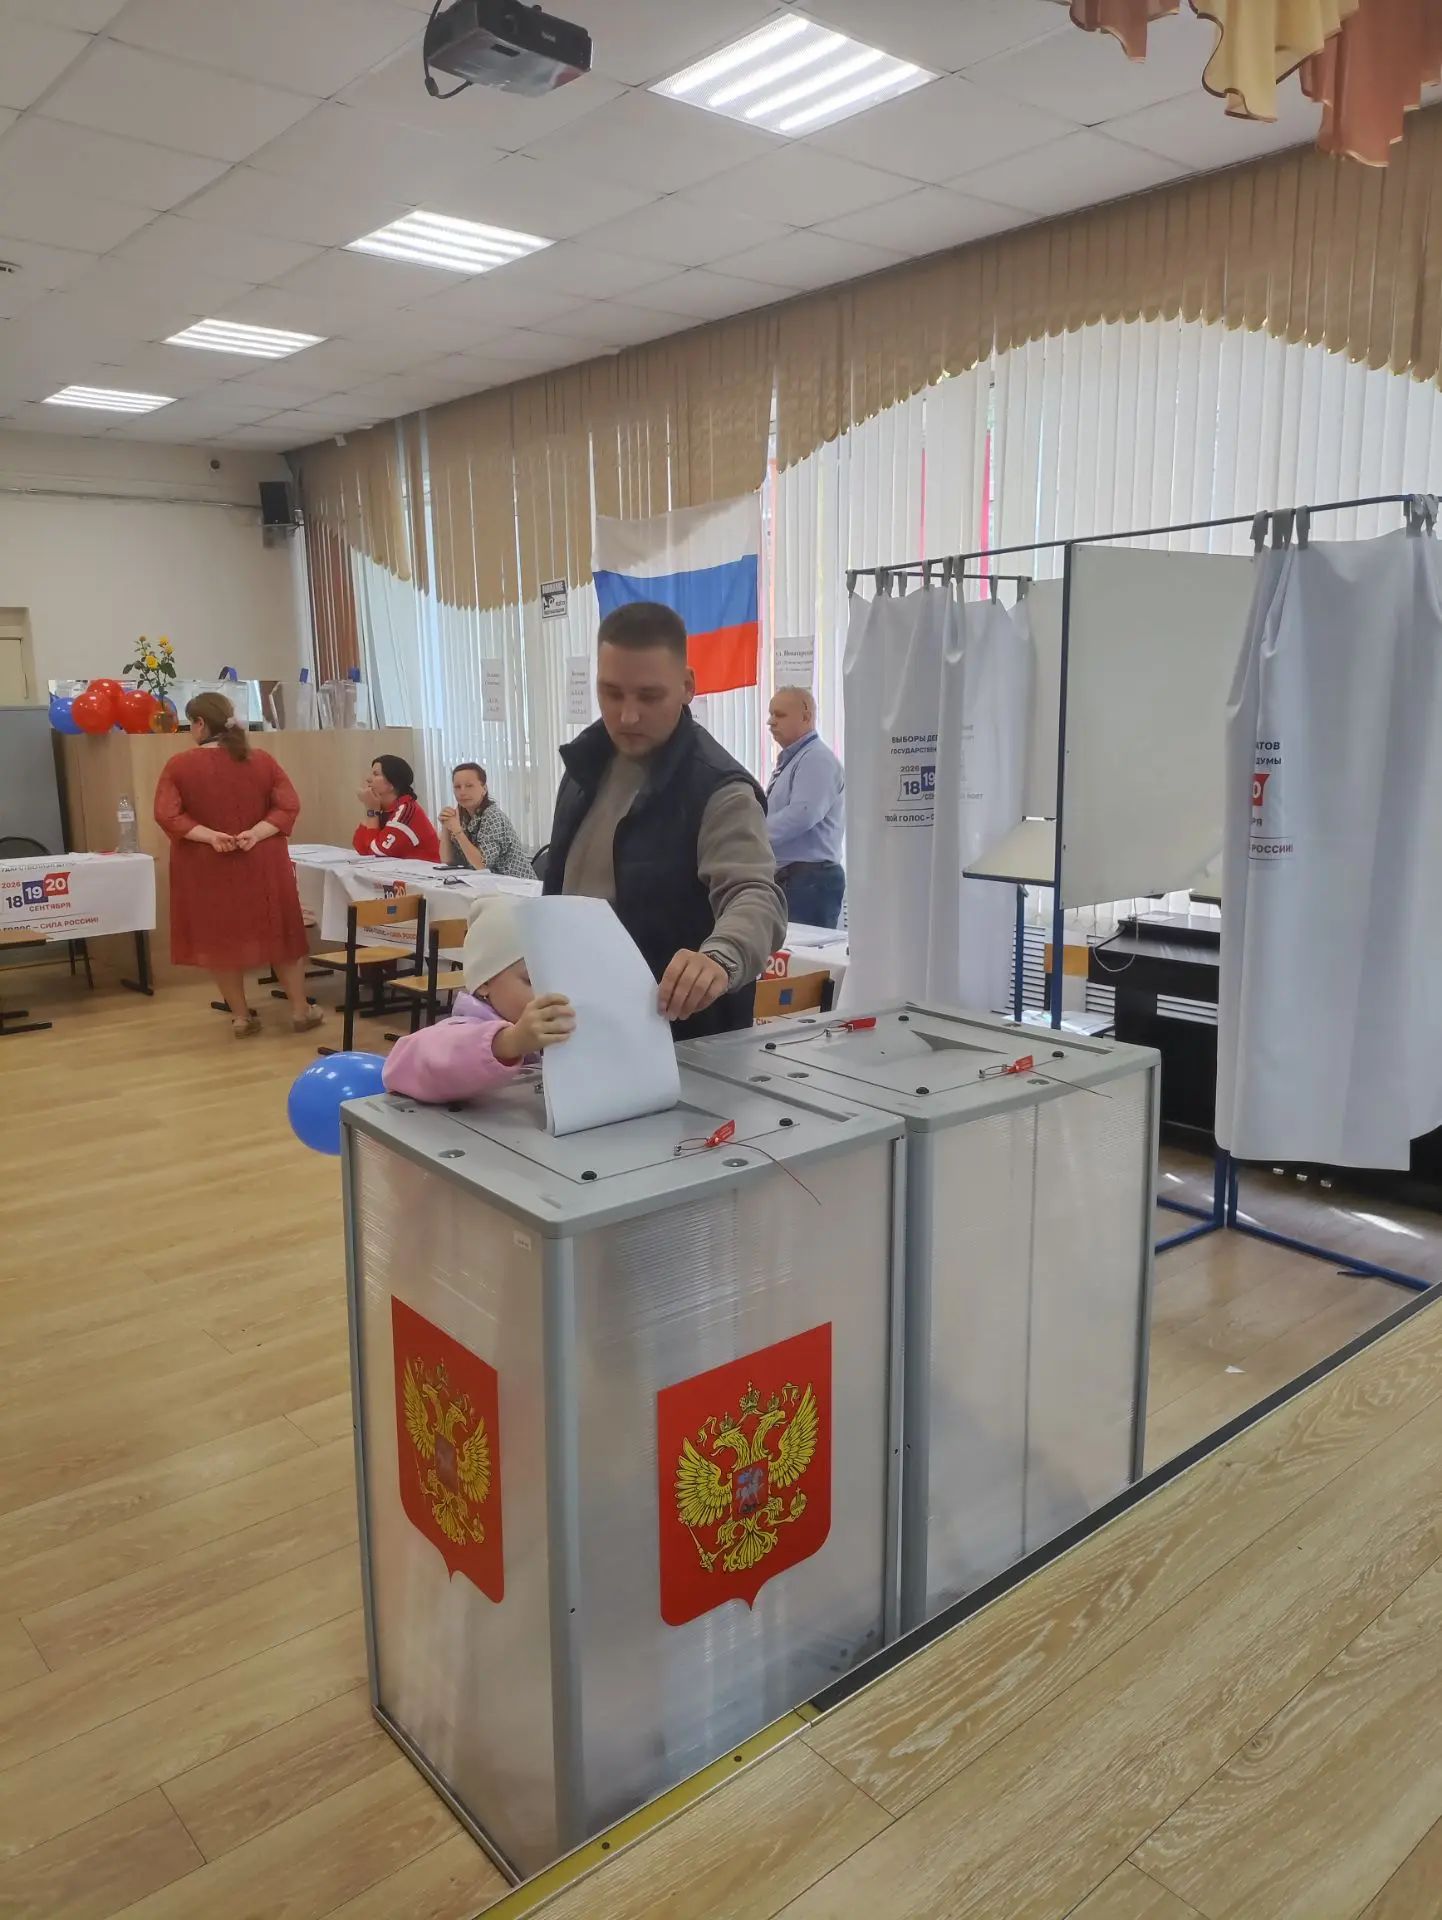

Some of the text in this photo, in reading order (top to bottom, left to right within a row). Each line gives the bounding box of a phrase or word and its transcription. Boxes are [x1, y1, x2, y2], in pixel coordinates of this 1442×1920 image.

[891, 735, 926, 743] ВЫБОРЫ
[903, 781, 921, 795] 18
[898, 814, 925, 822] ГОЛОС
[382, 833, 396, 849] 3
[5, 877, 67, 909] 18 19 20
[29, 901, 71, 912] СЕНТЯБРЯ
[40, 921, 62, 929] СИЛА
[64, 917, 99, 926] РОССИИ!
[765, 956, 786, 976] 20
